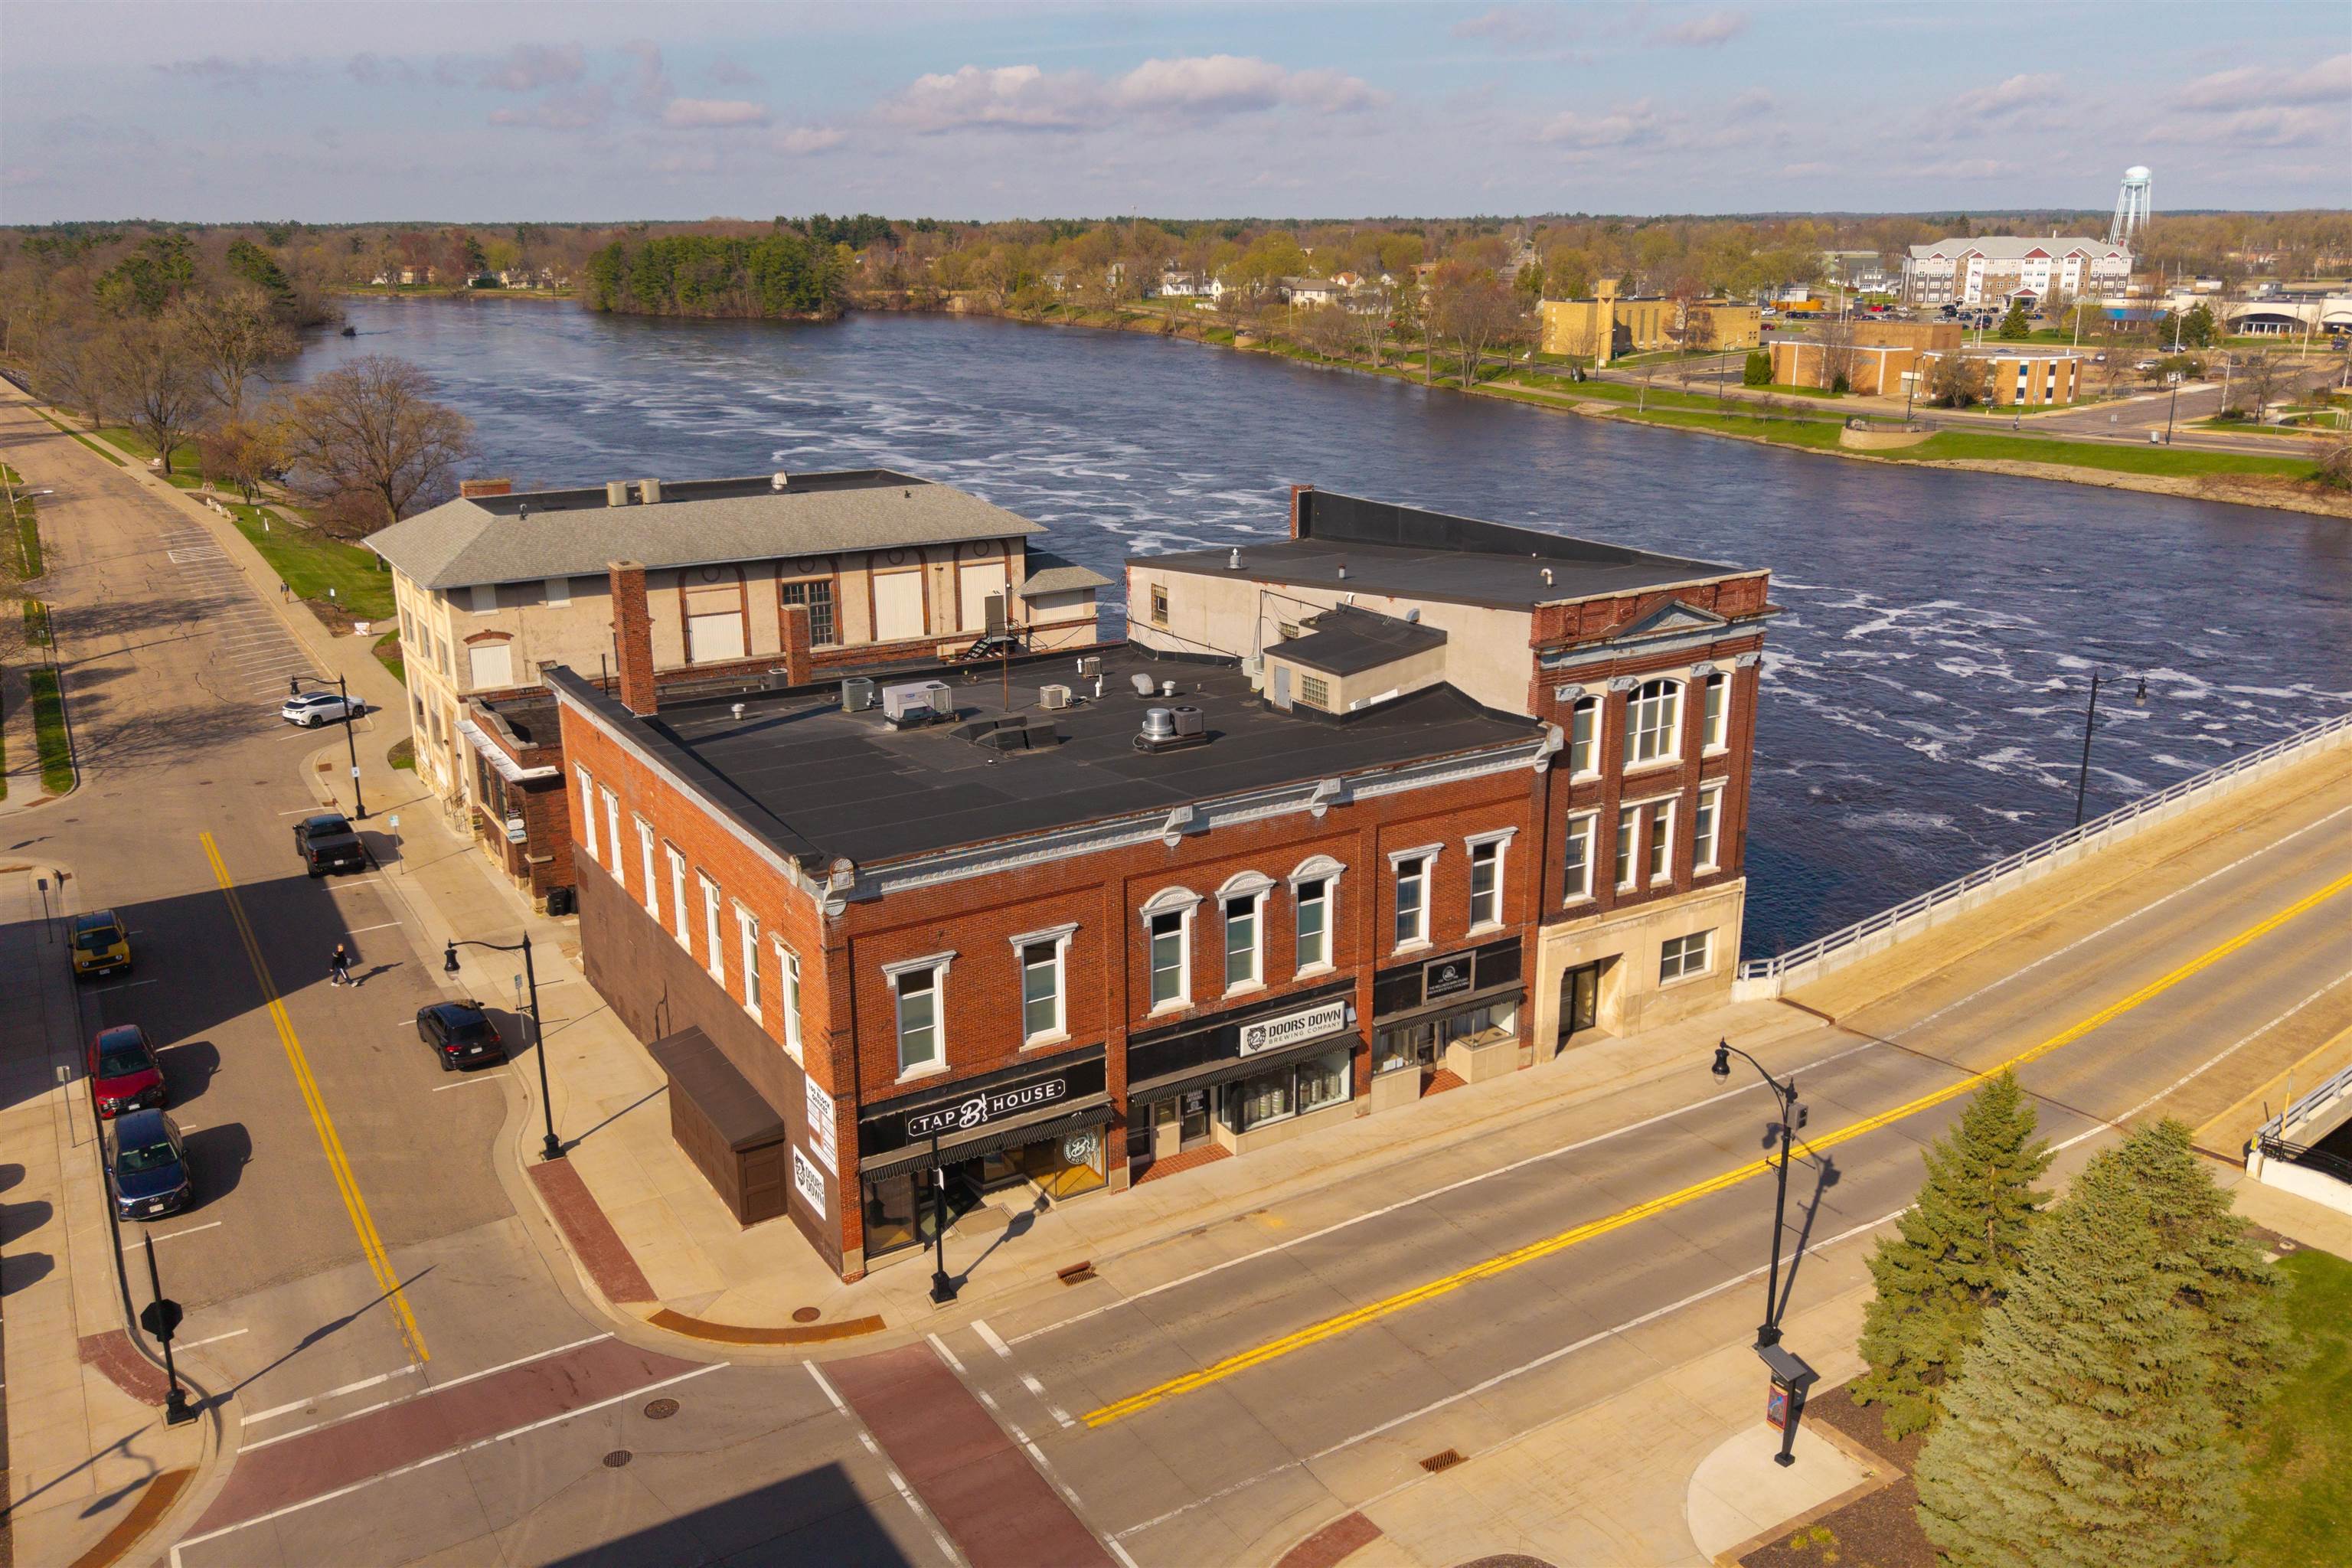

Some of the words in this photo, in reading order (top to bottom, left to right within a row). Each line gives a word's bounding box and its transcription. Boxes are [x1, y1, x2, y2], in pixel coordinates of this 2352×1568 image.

[1269, 1018, 1305, 1038] DOORS
[1308, 1008, 1341, 1027] DOWN
[1269, 1031, 1304, 1044] BREWING
[1307, 1021, 1341, 1034] COMPANY
[1250, 1031, 1261, 1046] 2
[920, 1111, 956, 1131] TAP
[993, 1083, 1056, 1112] HOUSE
[805, 1166, 824, 1195] DOORS
[805, 1178, 825, 1208] DOWN
